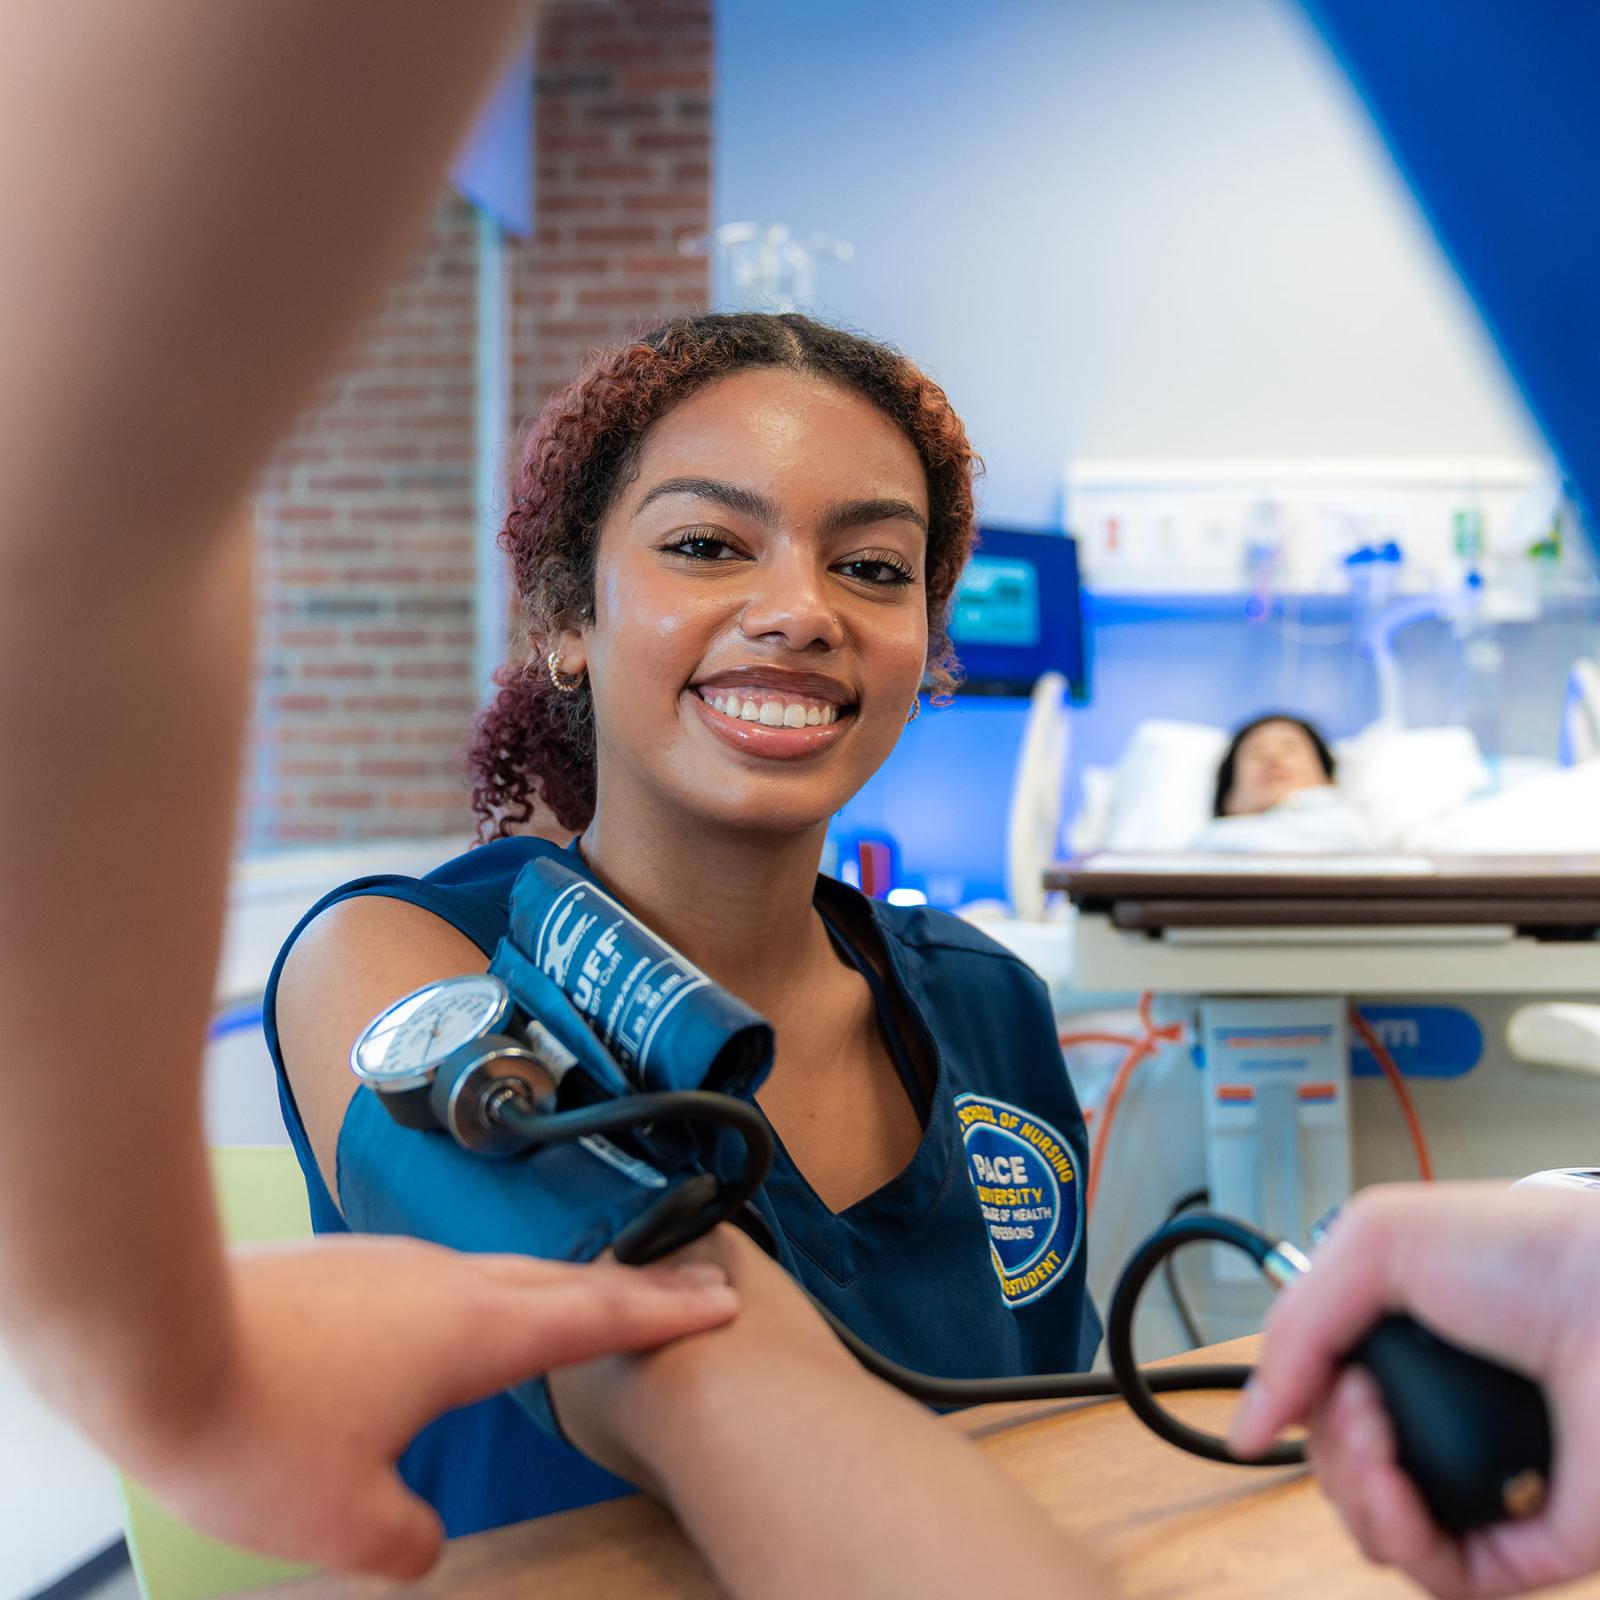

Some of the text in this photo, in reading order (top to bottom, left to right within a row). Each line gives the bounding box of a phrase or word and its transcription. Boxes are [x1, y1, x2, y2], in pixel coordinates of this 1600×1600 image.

[573, 927, 619, 1010] UFF
[972, 1154, 1029, 1185] PACE
[1000, 1112, 1020, 1129] OF
[1019, 1121, 1074, 1183] NURSING
